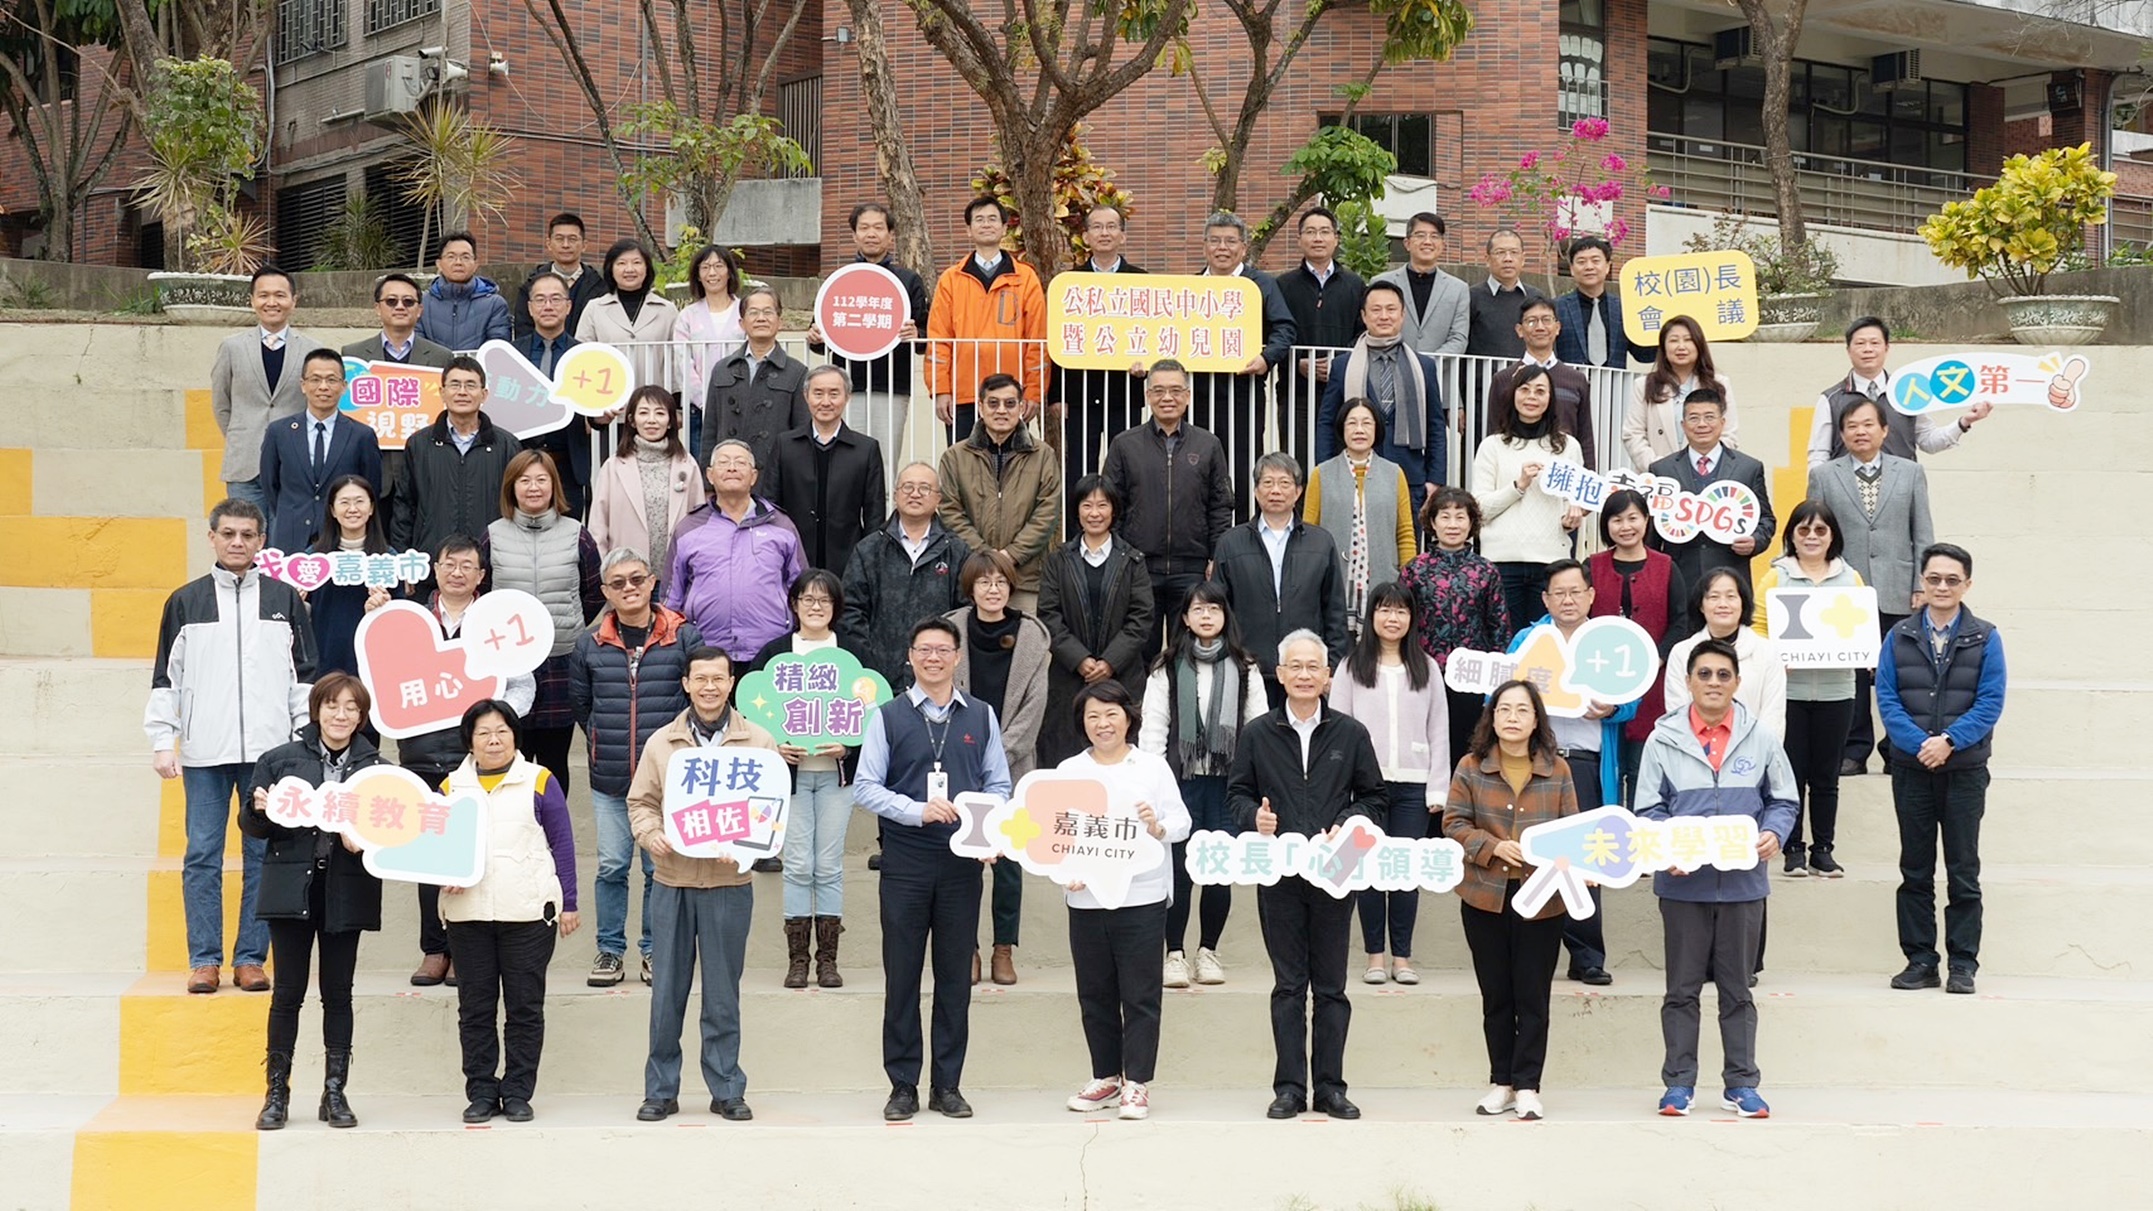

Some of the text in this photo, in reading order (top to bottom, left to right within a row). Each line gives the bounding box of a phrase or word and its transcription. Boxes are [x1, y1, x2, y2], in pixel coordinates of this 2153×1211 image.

[1634, 264, 1742, 298] 校(園)長
[832, 295, 893, 310] 112學年度
[1063, 286, 1242, 320] 公私立國民中小學
[832, 311, 892, 330] 第二學期
[1062, 323, 1242, 357] 暨公立幼兒園
[352, 376, 420, 406] 國際
[486, 371, 550, 408] 動力
[572, 367, 615, 396] +1
[1903, 364, 2046, 406] 人文第一
[253, 551, 431, 585] 我愛嘉義市
[484, 613, 535, 651] +1
[1585, 644, 1637, 678] +1
[1780, 651, 1871, 663] CHIAYI CITY
[399, 672, 463, 709] 用心
[774, 663, 838, 692] 精緻
[784, 698, 864, 736] 創新
[681, 756, 763, 797] 科技
[276, 785, 451, 836] 永續教育
[681, 807, 745, 839] 相佐
[1053, 811, 1138, 841] 嘉義市
[1051, 843, 1136, 860] CHIAYI CITY
[1582, 825, 1750, 866] 未來學習
